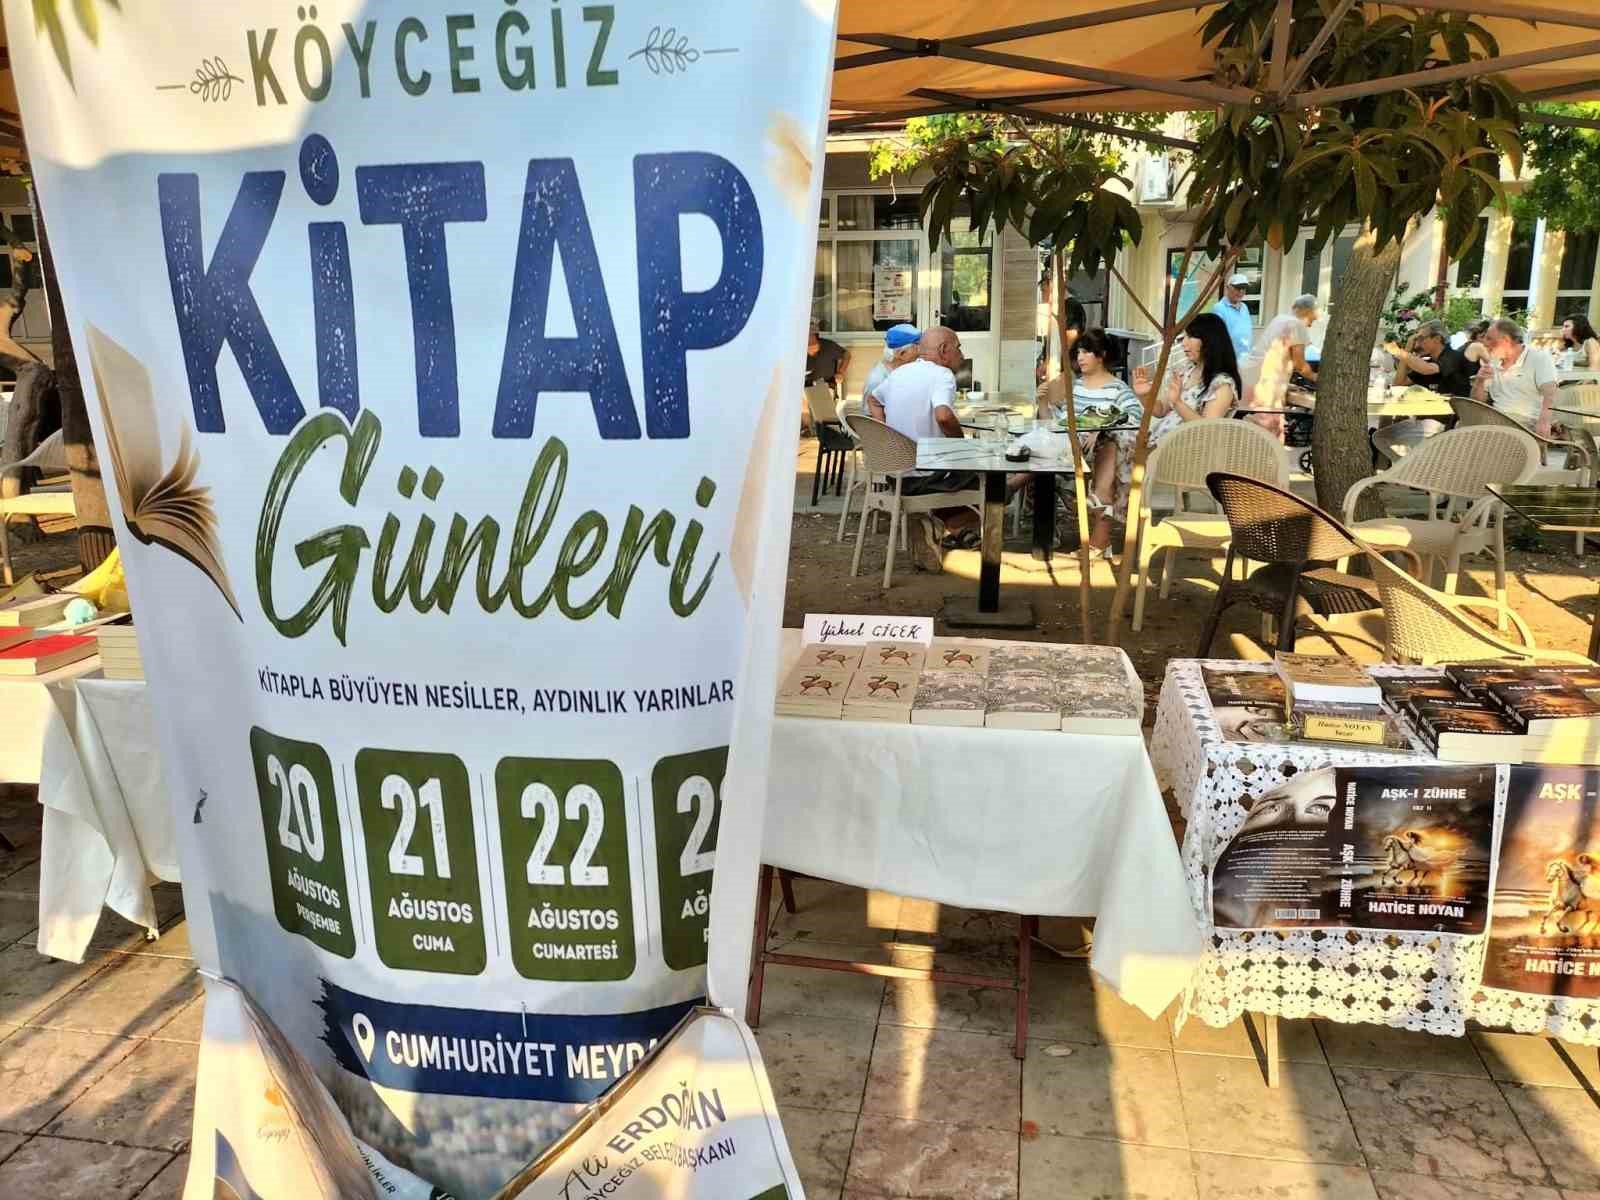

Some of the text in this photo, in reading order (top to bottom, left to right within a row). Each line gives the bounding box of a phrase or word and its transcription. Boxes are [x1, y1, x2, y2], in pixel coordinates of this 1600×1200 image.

[247, 0, 619, 106] KÖYCEĞİZ
[157, 133, 764, 440] KİTAP
[255, 408, 720, 647] Günleri
[819, 620, 865, 642] Yüksel
[257, 665, 735, 715] KİTAPLA BÜYÜYEN NESİLLER, AYDINLIK YARINLAR
[267, 754, 325, 862] 20
[1423, 786, 1467, 799] ZÜHRE
[1539, 783, 1583, 803] AŞK
[380, 774, 452, 879] 21
[520, 782, 608, 886] 22
[676, 775, 722, 877] 2
[287, 867, 341, 909] AĞUSTOS
[387, 893, 474, 924] AĞUSTOS
[1368, 900, 1464, 918] HATİCE NOYAN
[296, 902, 342, 935] PERŞEMBE
[527, 902, 619, 931] AĞUSTOS
[412, 934, 455, 954] CUMA
[532, 940, 619, 960] CUMARTESİ
[1525, 957, 1585, 976] HATİCE
[385, 1033, 556, 1077] CUMHURİYET
[607, 1080, 726, 1154] ERDOĞAN
